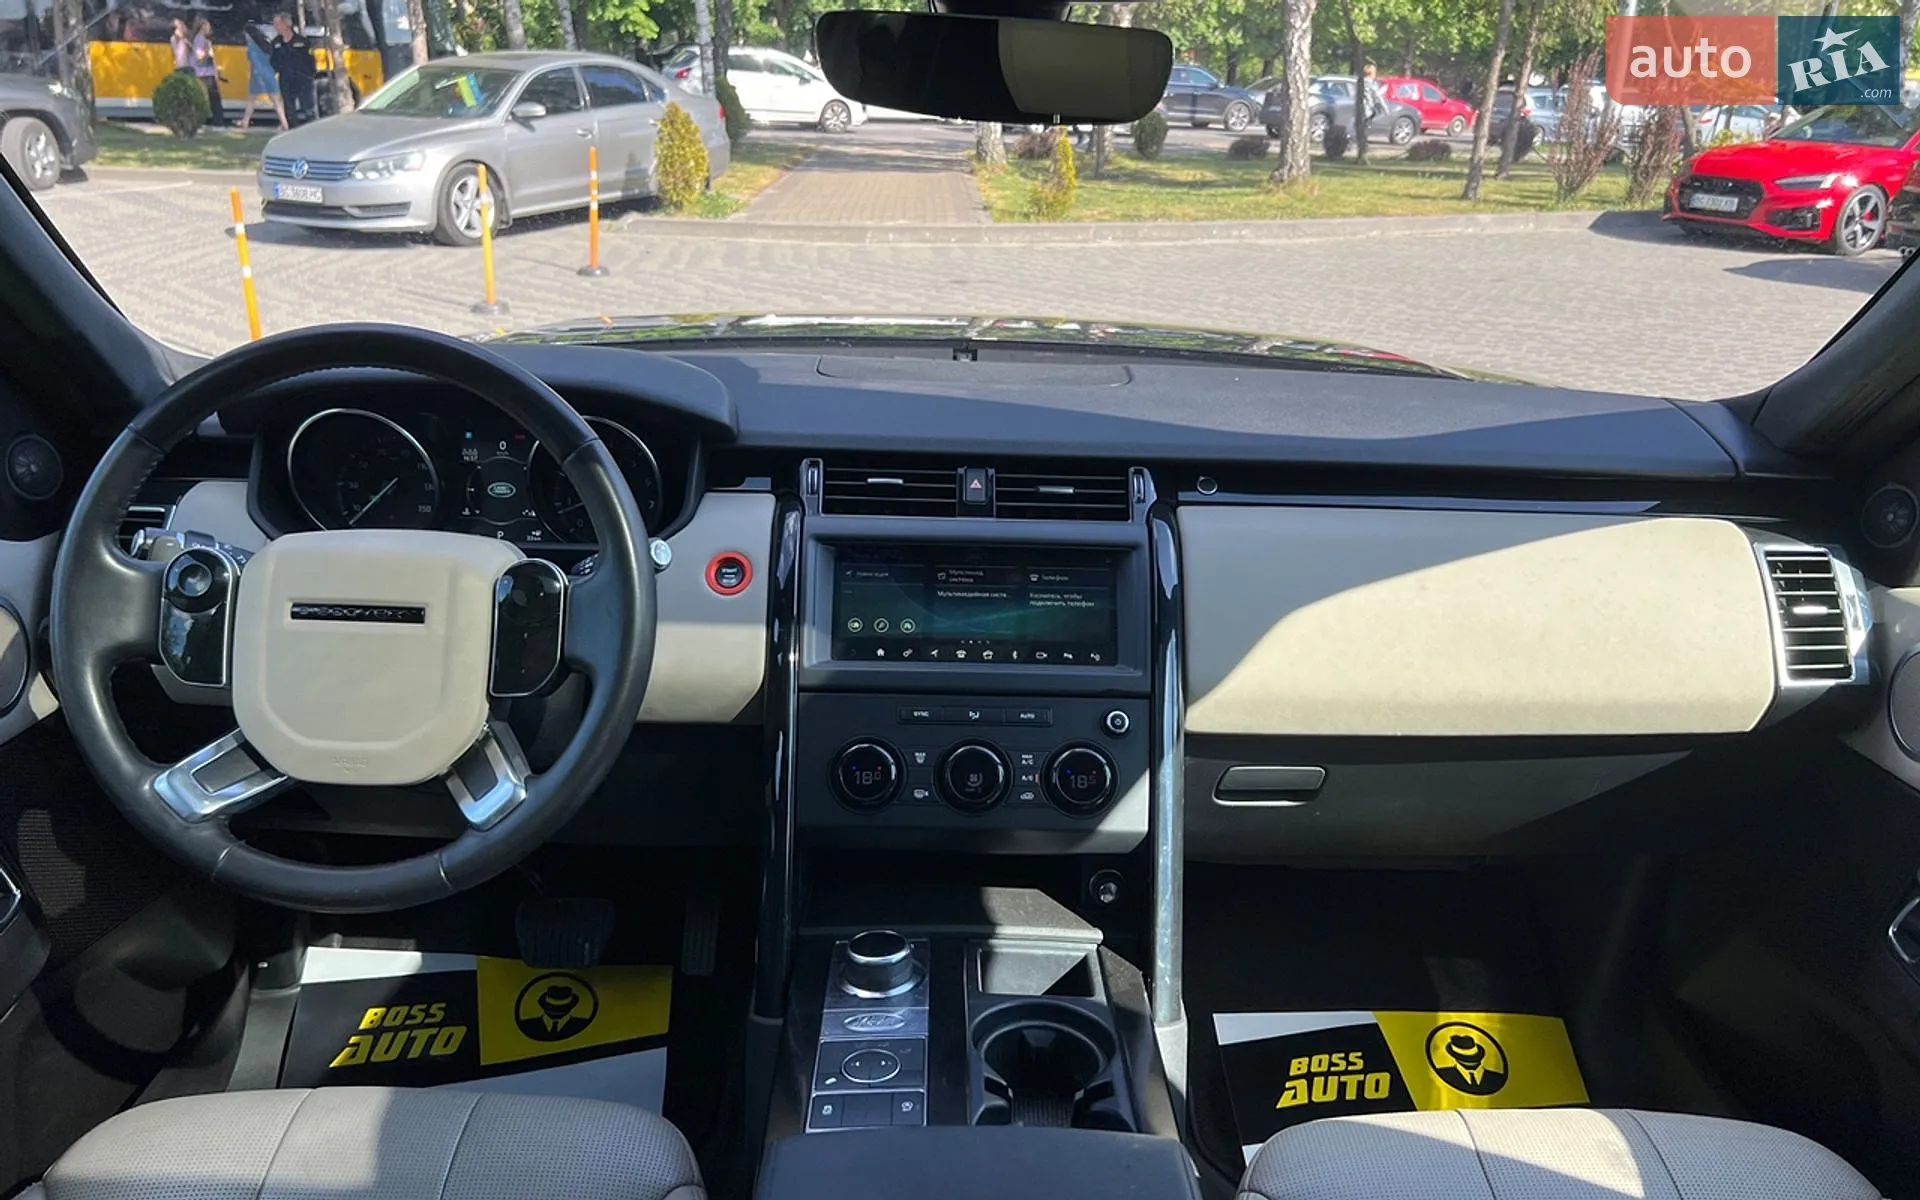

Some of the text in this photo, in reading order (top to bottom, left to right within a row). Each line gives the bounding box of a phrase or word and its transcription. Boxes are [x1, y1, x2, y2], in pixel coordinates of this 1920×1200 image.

[499, 440, 507, 450] 0
[497, 530, 504, 539] P
[359, 1002, 446, 1030] BOSS
[329, 1025, 467, 1068] AUTO
[1289, 1052, 1364, 1076] BOSS
[1276, 1072, 1391, 1109] AUTO
